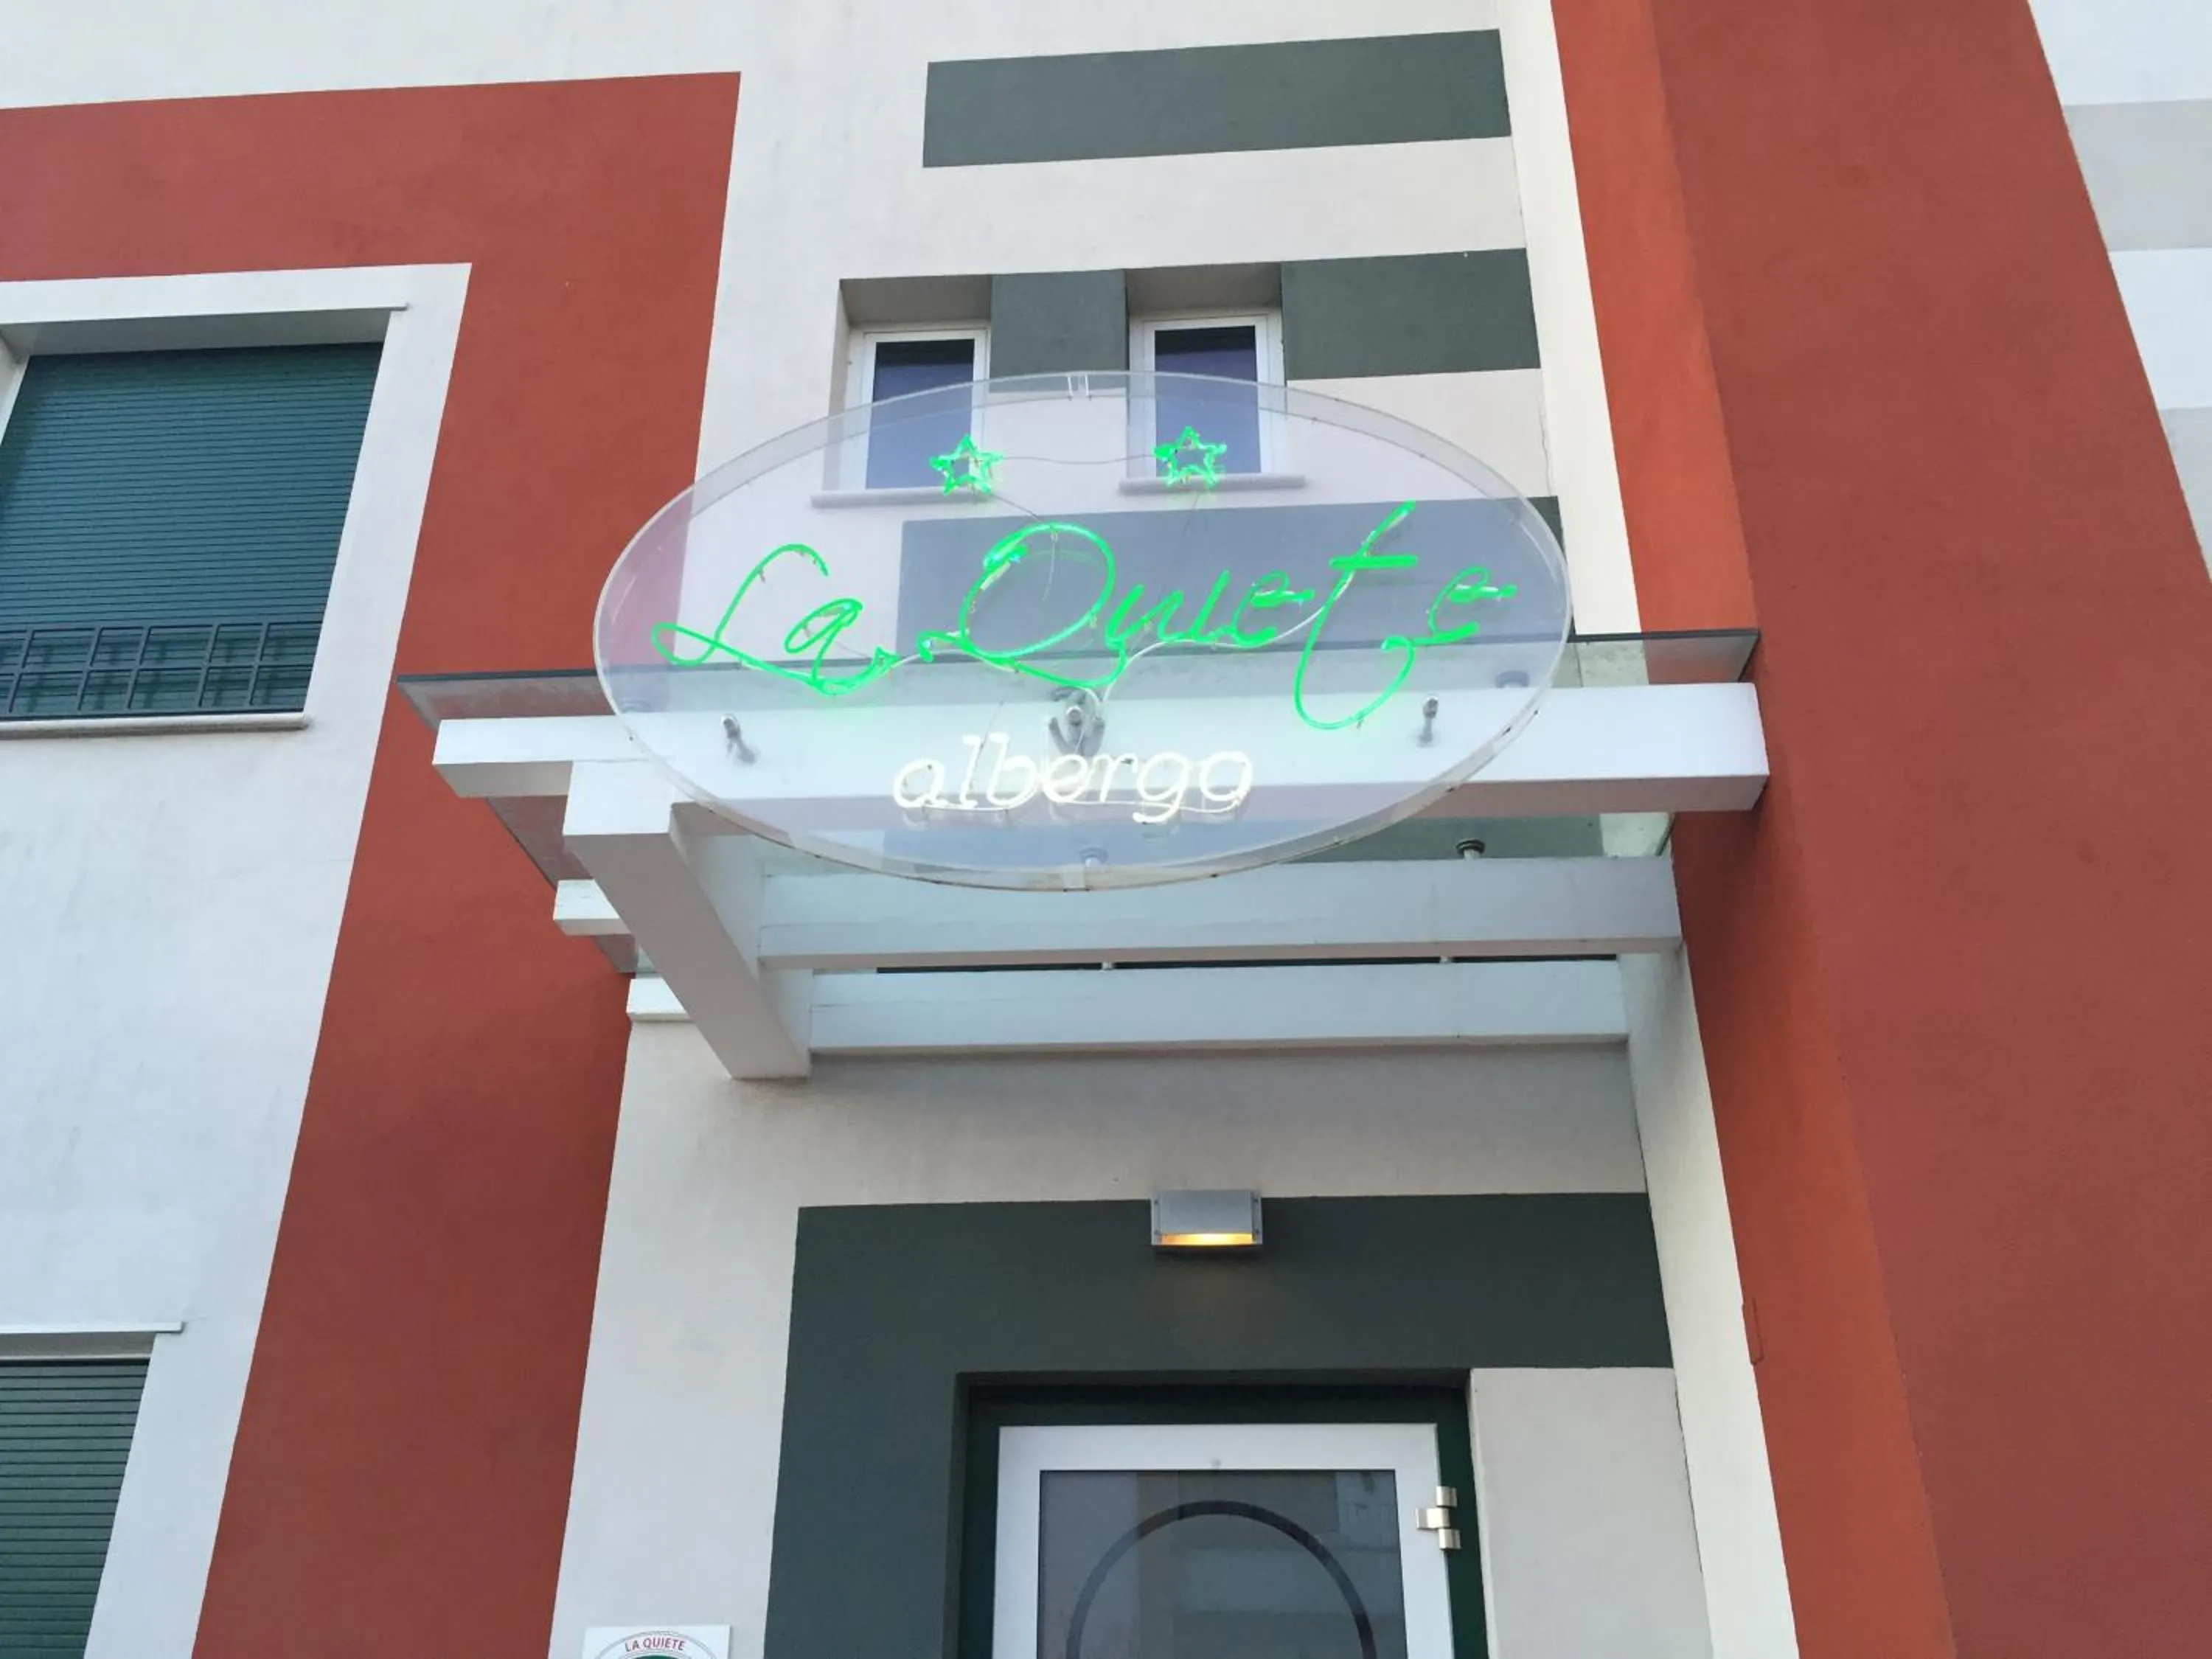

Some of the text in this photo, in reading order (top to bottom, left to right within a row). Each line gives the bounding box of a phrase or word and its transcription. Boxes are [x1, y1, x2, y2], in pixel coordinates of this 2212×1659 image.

[651, 501, 1517, 731] La Quiete
[893, 733, 1252, 824] albergo
[625, 1638, 686, 1652] LA QUIETE
